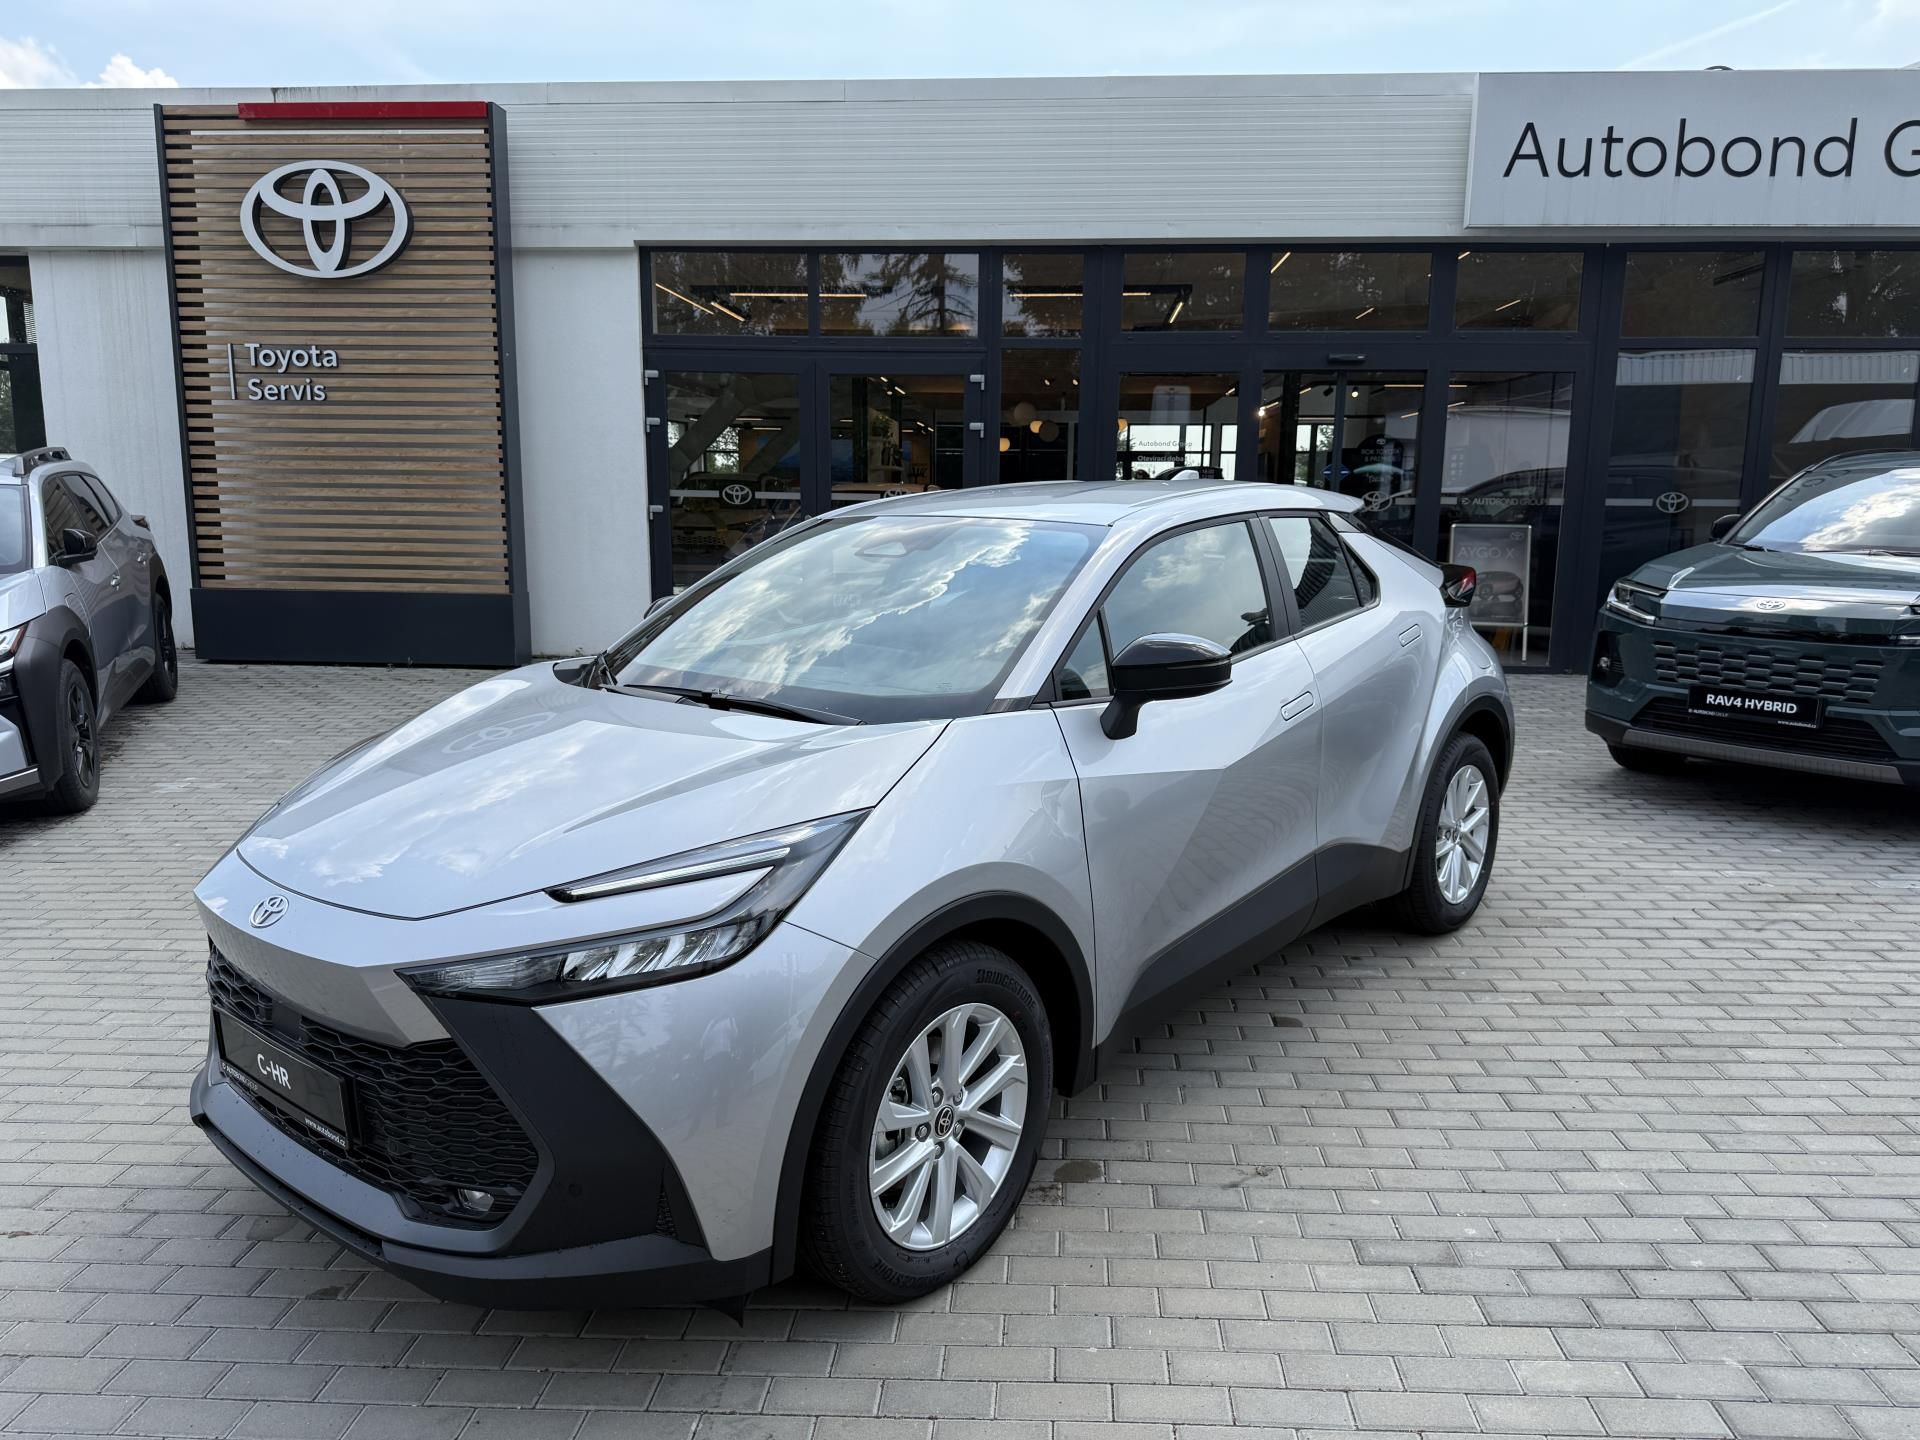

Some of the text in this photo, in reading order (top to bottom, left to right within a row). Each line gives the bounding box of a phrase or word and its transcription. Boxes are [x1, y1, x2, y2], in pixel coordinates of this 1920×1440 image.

[1503, 118, 1858, 178] Autobond
[244, 343, 338, 374] Toyota
[248, 378, 326, 401] Servis
[1457, 547, 1515, 559] AYGO X
[1706, 694, 1797, 714] RAV4 HYBRID
[976, 969, 1036, 1010] BRIDGESTONE
[257, 1053, 292, 1090] C-HR
